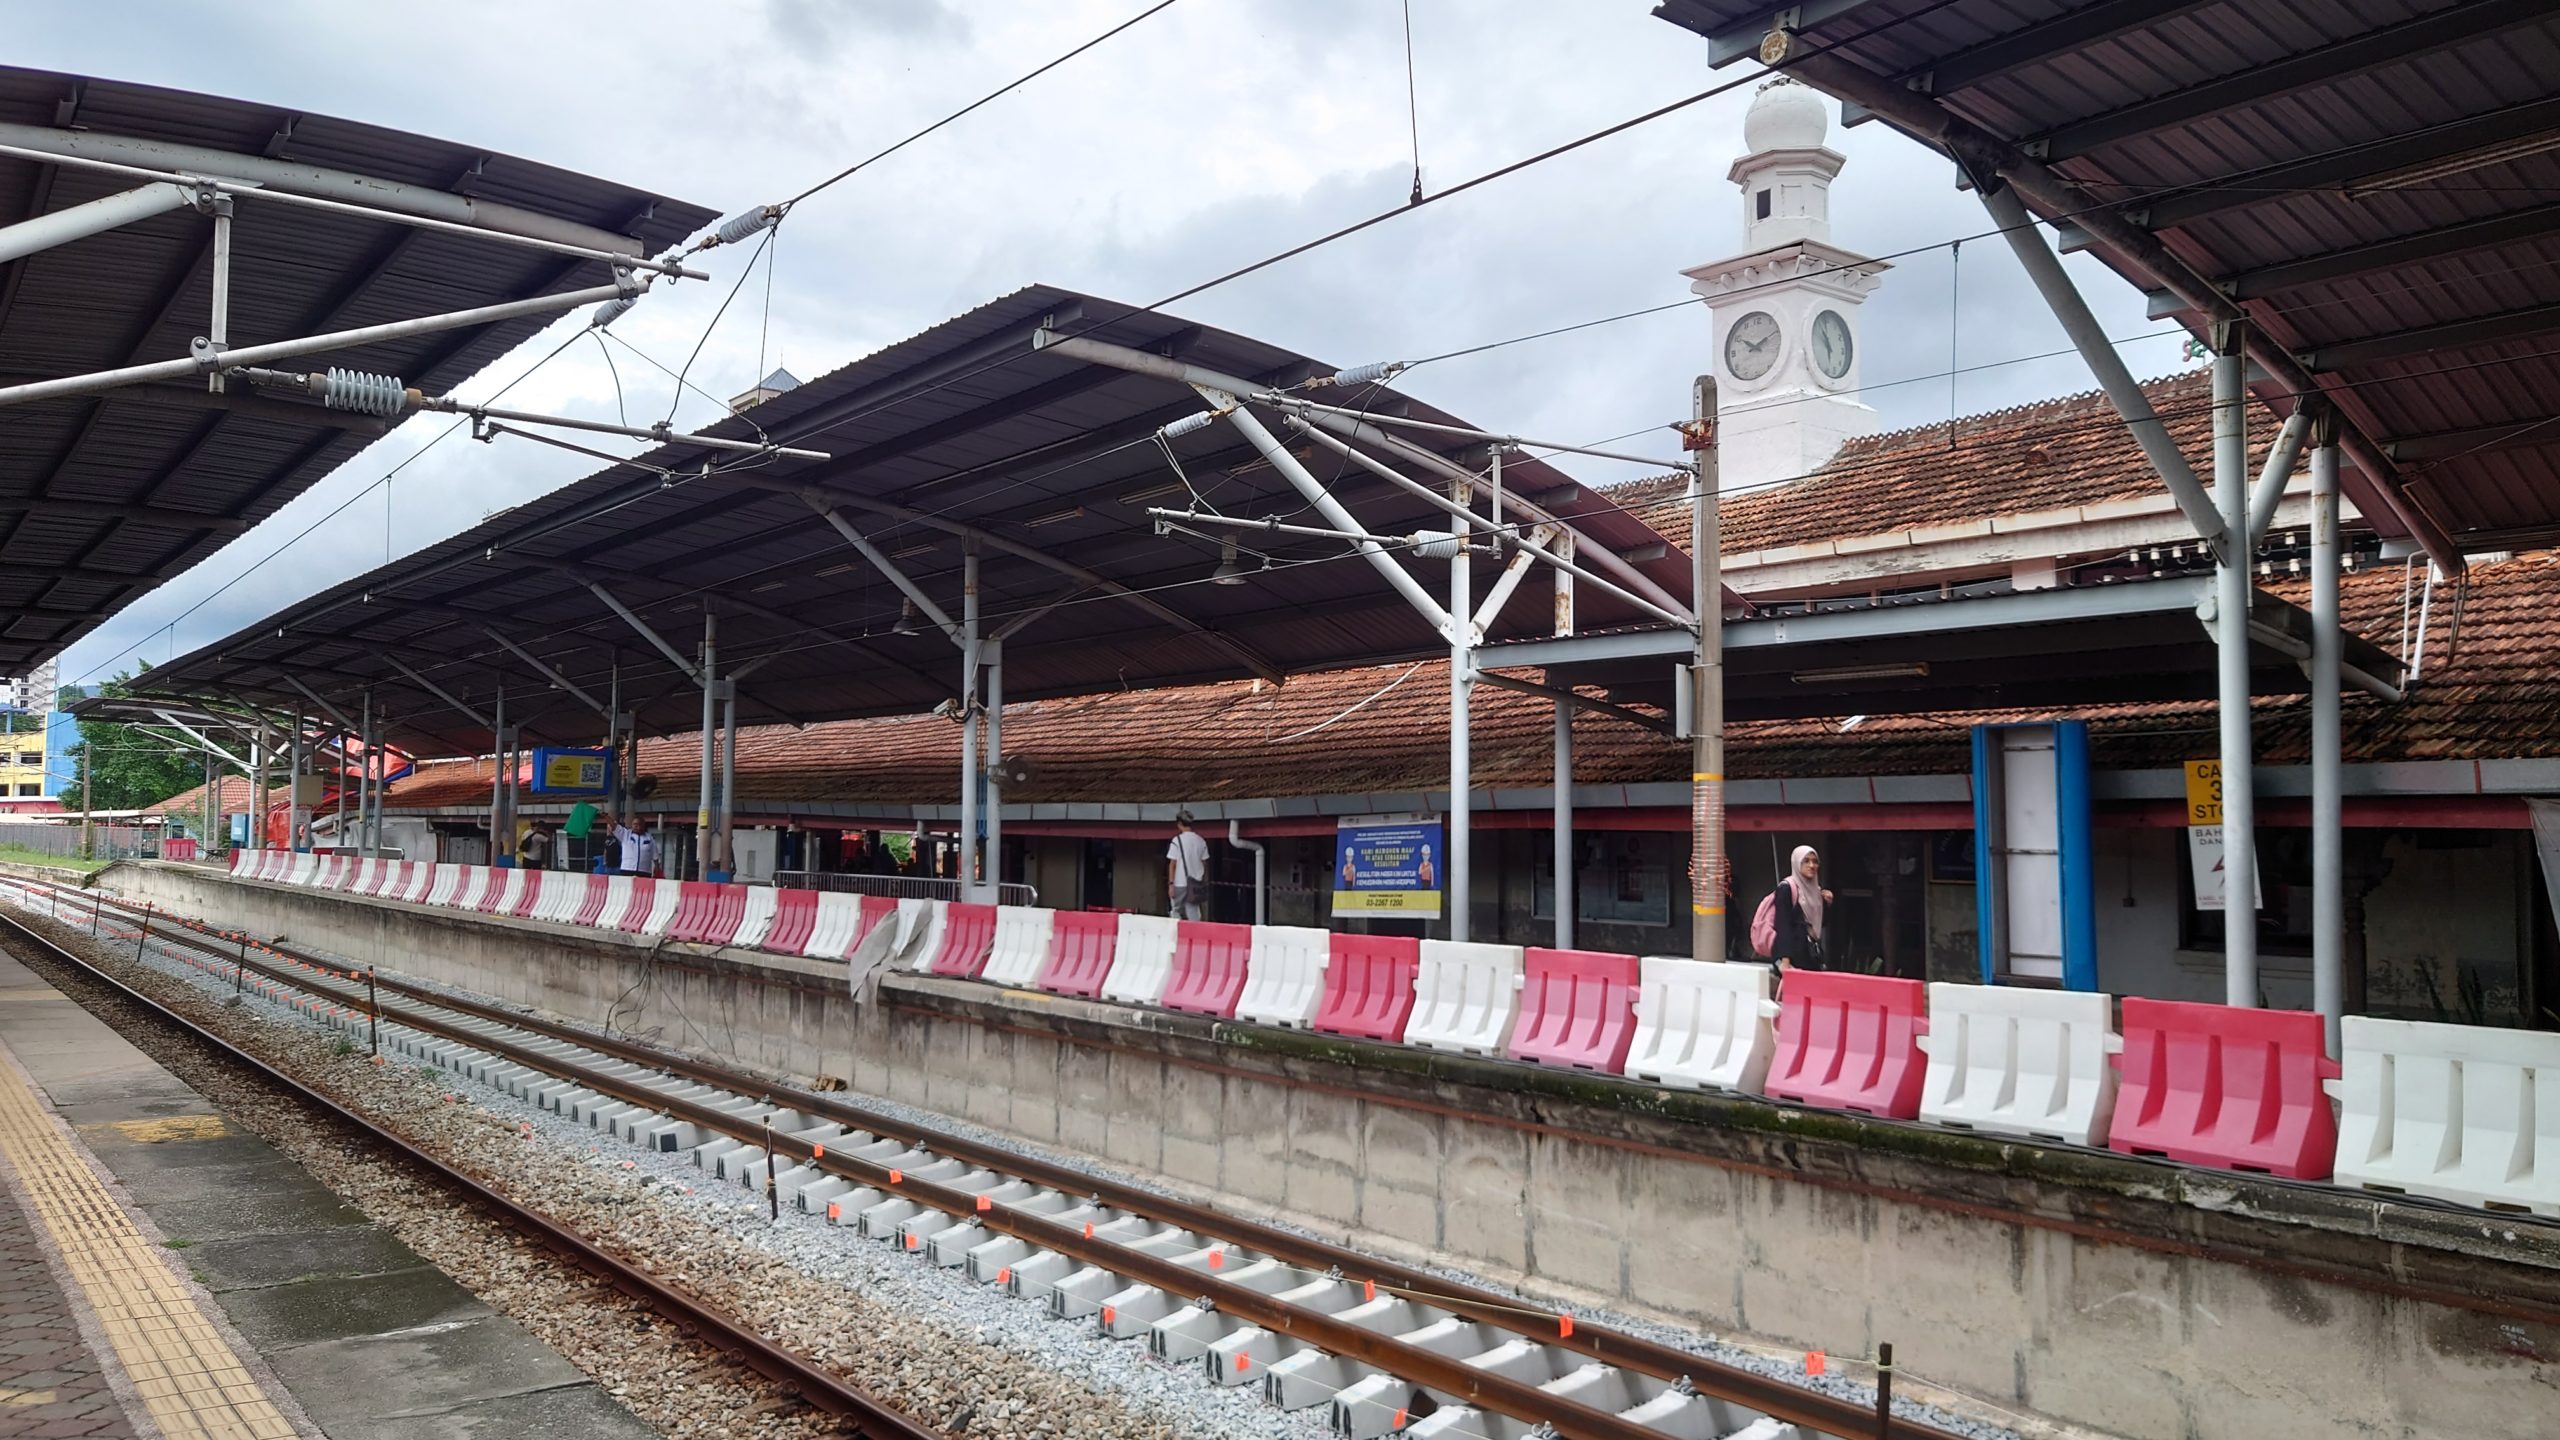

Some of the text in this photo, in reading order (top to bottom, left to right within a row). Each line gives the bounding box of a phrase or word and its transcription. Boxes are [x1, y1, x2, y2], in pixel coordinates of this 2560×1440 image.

[1753, 317, 1762, 325] 12
[2197, 764, 2222, 779] CA
[2210, 780, 2223, 802] 3
[2195, 803, 2223, 819] ST
[2195, 828, 2222, 838] BAH
[2199, 837, 2222, 846] DAN
